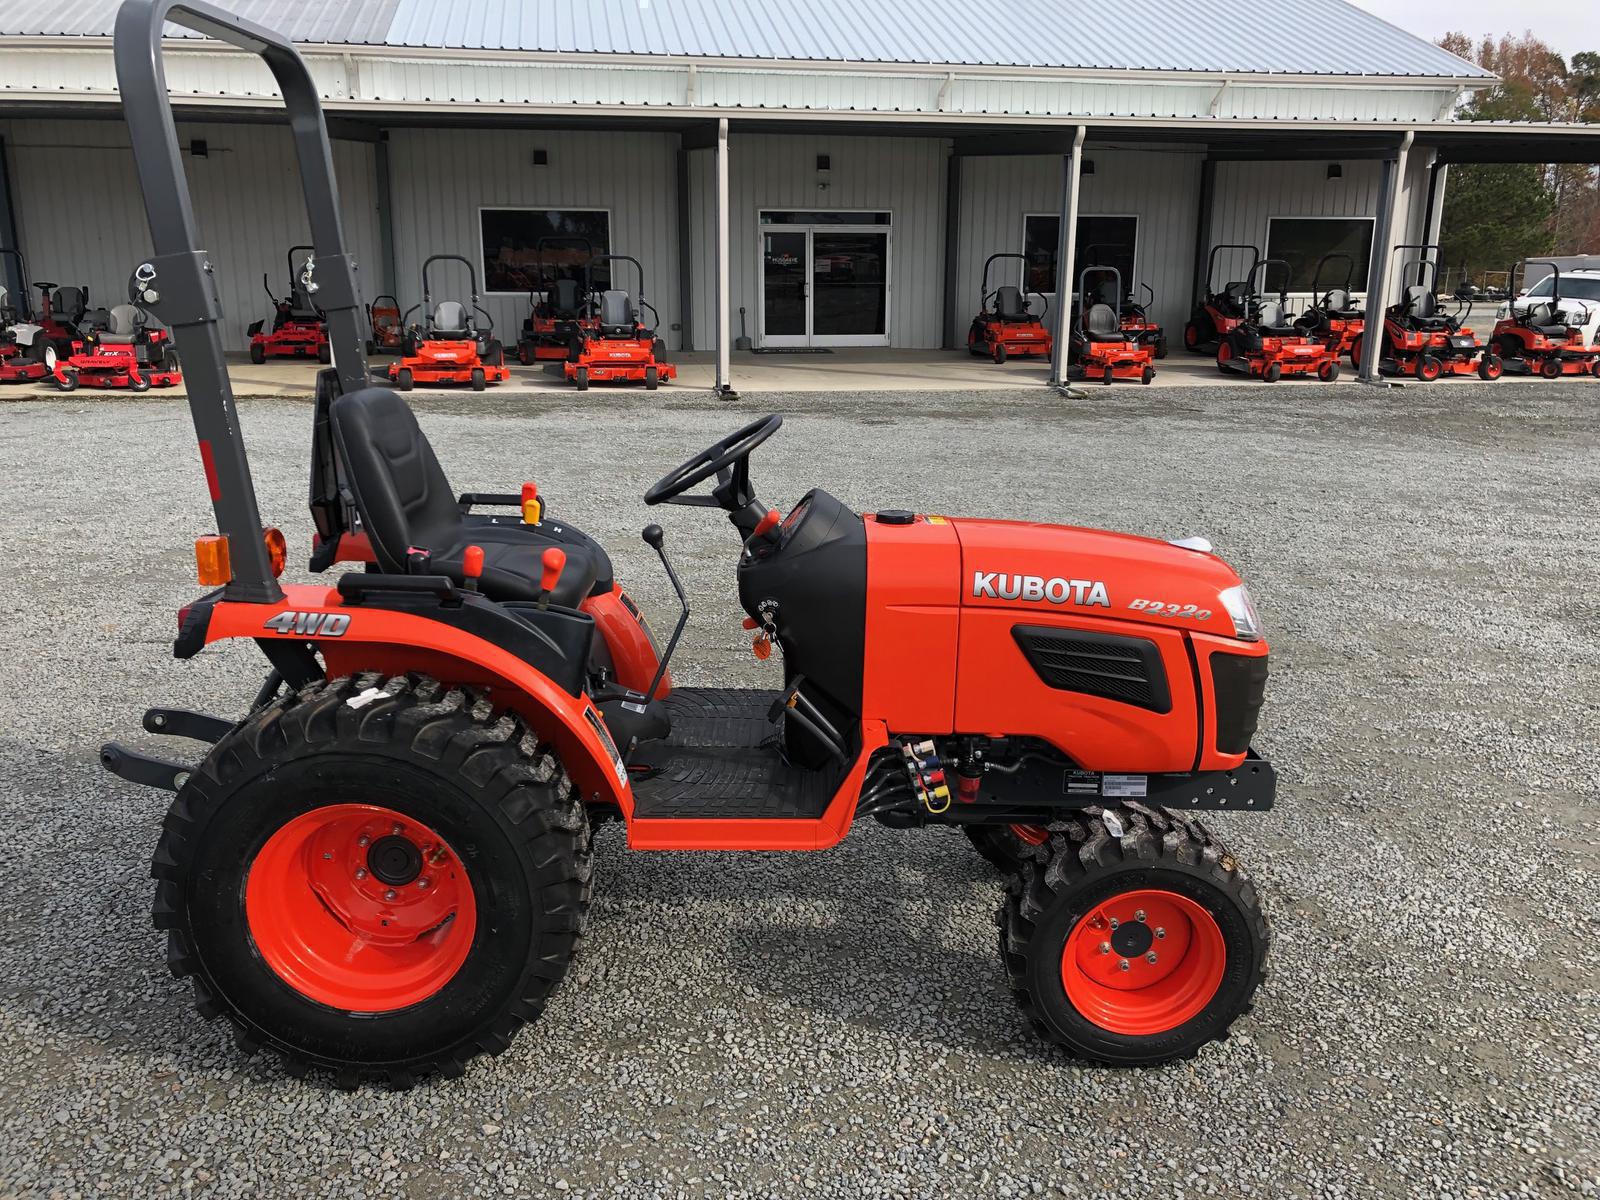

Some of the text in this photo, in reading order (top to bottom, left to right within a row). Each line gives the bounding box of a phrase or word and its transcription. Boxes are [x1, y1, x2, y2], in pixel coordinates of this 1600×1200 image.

[972, 571, 1111, 607] KUBOTA
[1127, 598, 1212, 621] B2320
[263, 611, 352, 637] 4WD
